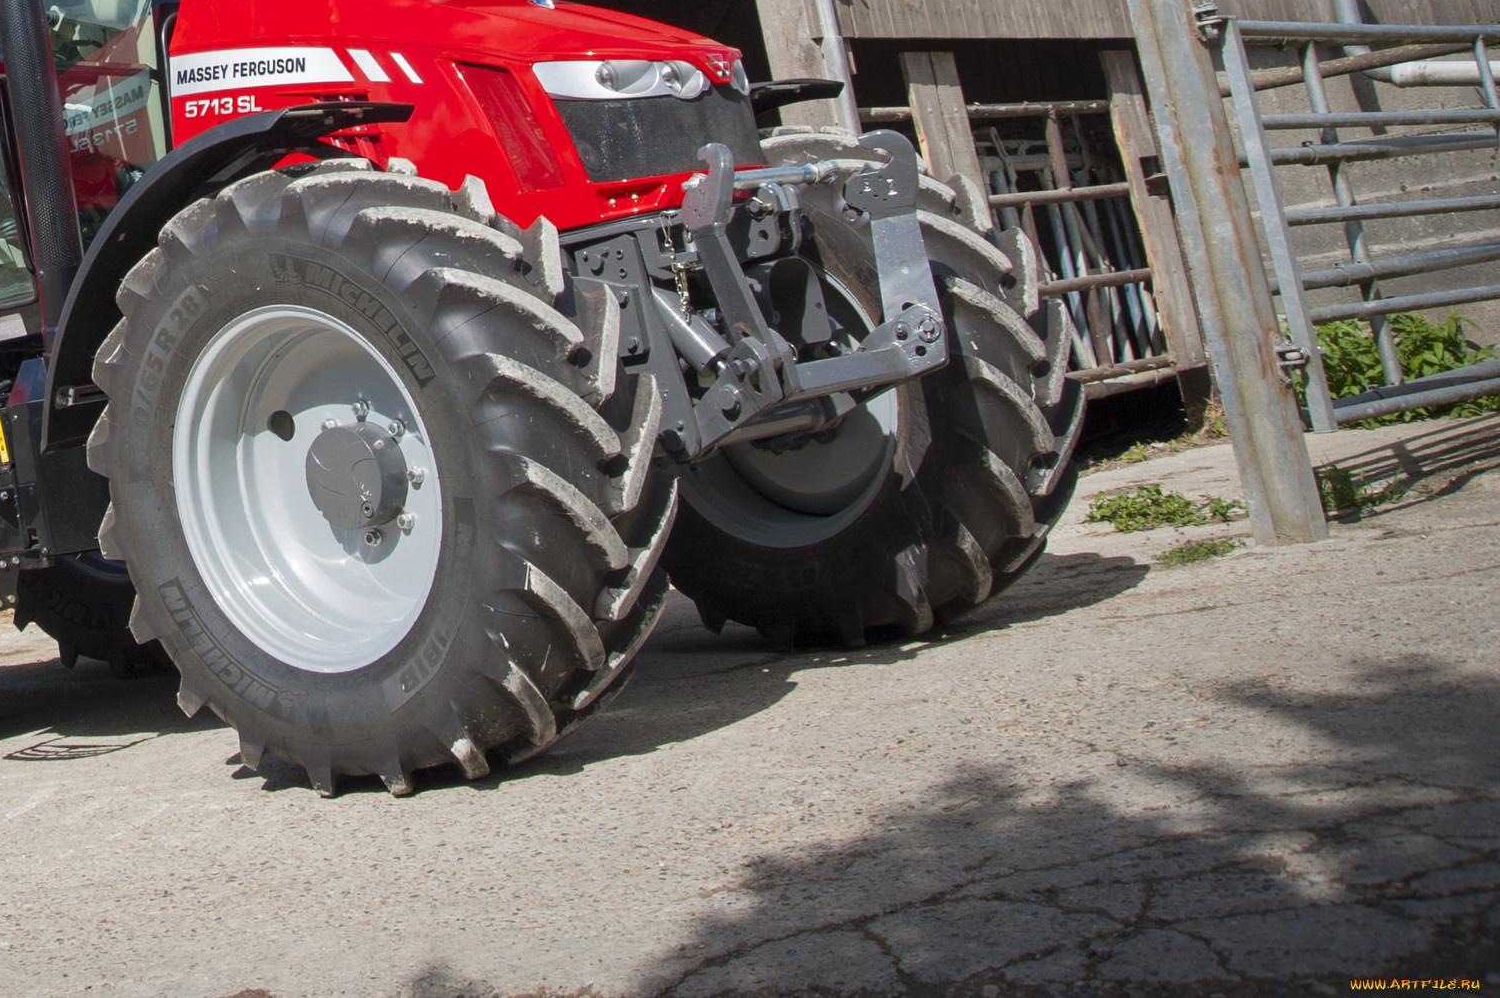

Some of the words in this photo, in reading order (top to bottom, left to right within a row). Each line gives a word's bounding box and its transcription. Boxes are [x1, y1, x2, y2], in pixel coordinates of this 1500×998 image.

[176, 64, 229, 85] MASSEY
[232, 57, 306, 78] FERGUSON
[185, 97, 234, 118] 5713
[237, 96, 262, 113] SL
[154, 327, 177, 354] R
[169, 294, 199, 331] 28
[304, 262, 434, 381] MICHELIN
[159, 585, 277, 709] MICHELIN
